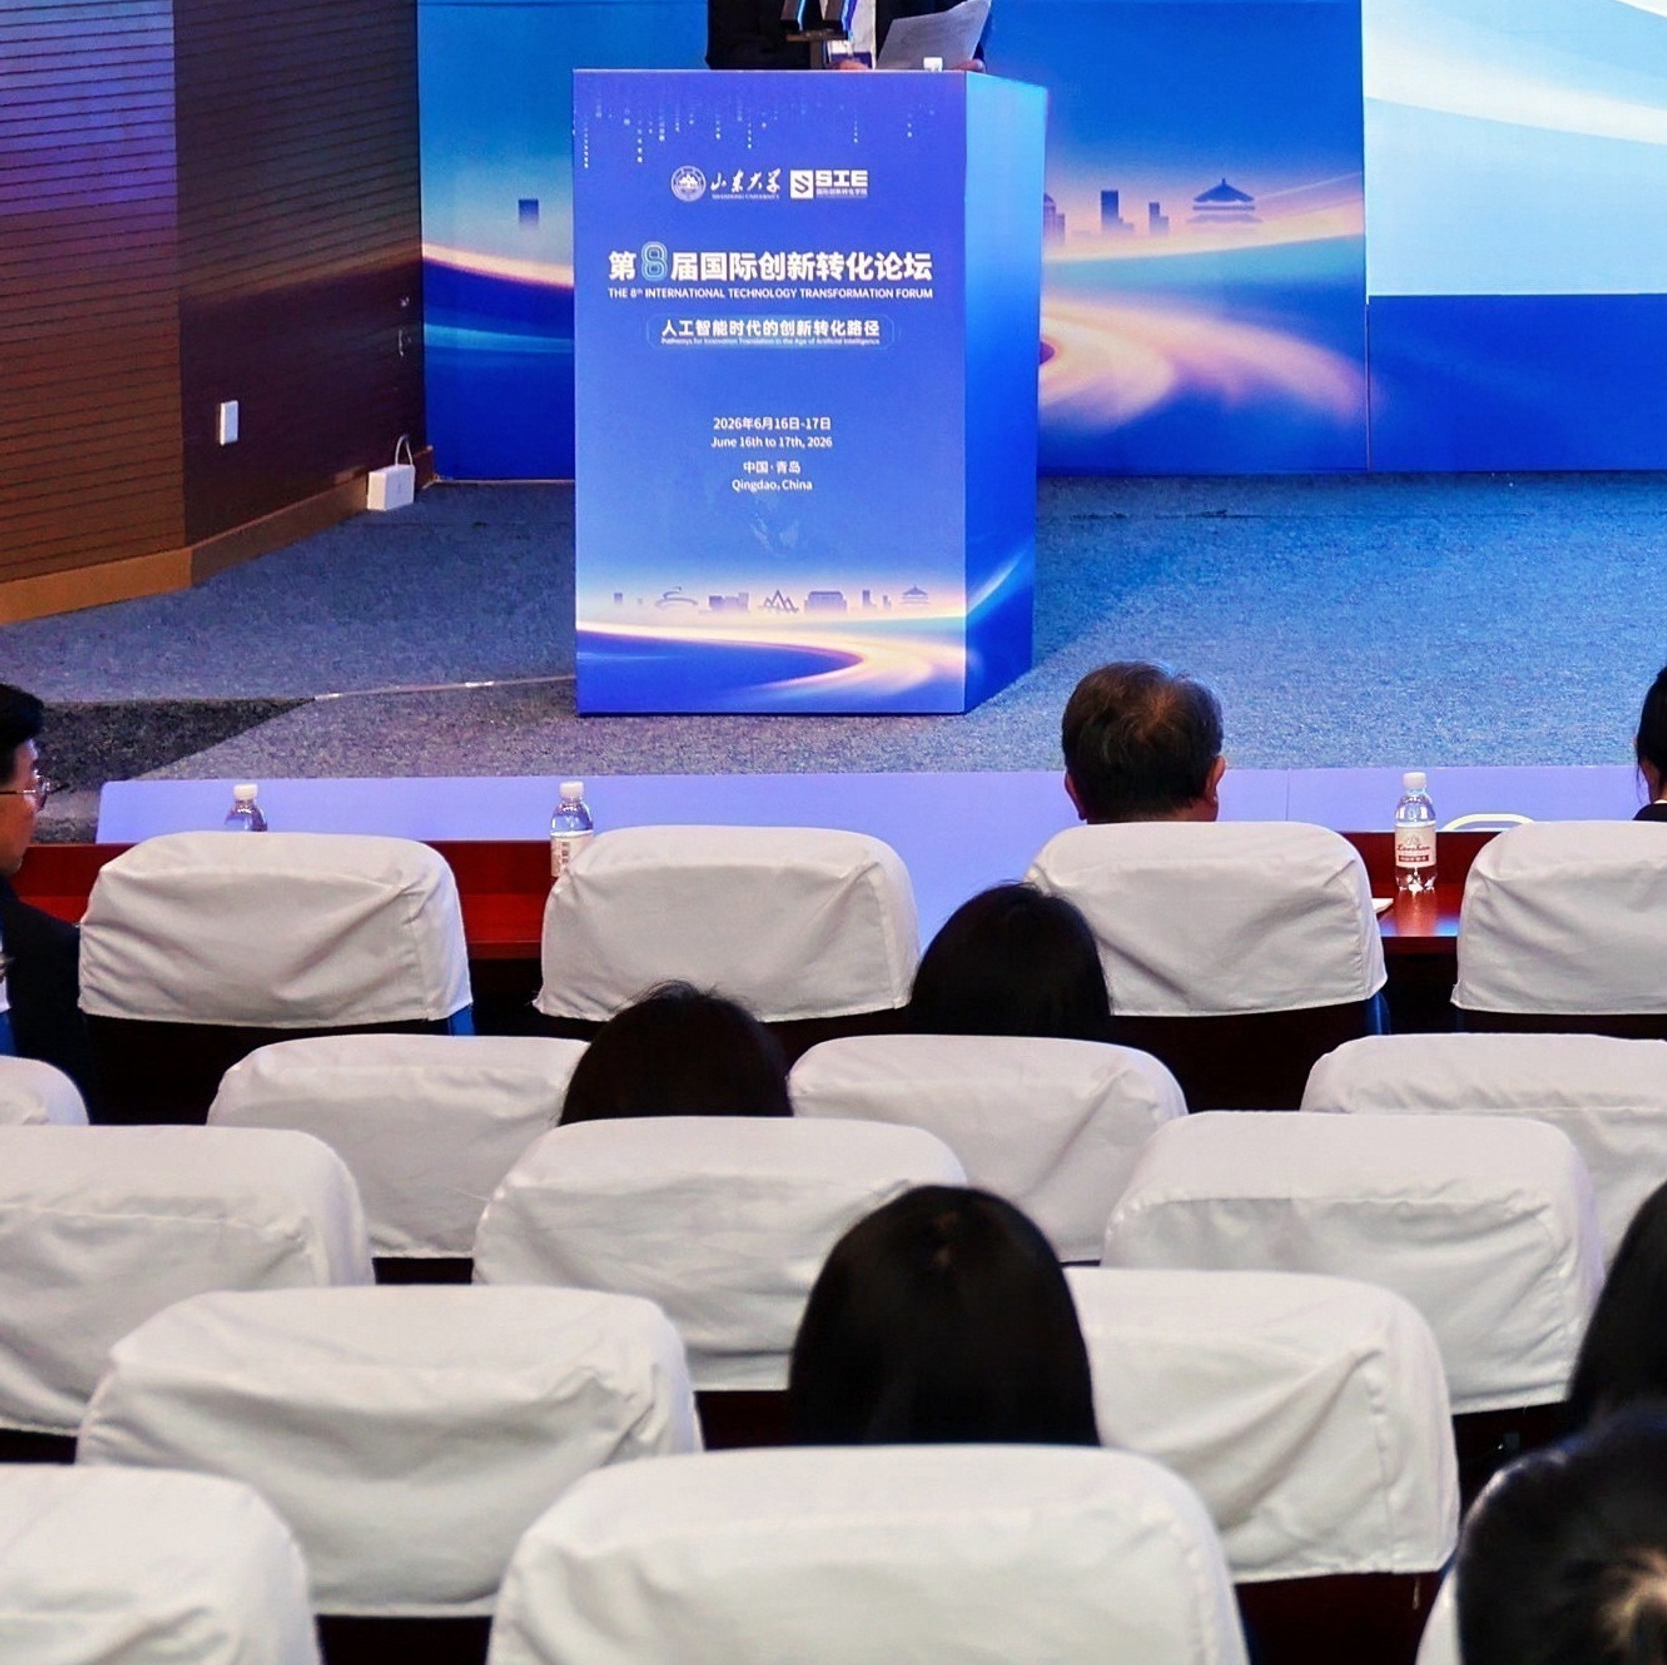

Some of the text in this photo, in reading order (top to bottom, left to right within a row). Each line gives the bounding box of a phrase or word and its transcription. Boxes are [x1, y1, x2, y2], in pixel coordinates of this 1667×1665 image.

[816, 171, 867, 187] SIE
[609, 288, 627, 298] THE
[645, 288, 724, 298] INTERNATIONAL
[729, 289, 796, 298] TECHNOLOGY
[800, 289, 893, 298] TRANSFORMATION
[896, 289, 932, 298] FORUM
[663, 320, 879, 336] 人工智能时代的创新转化路径
[714, 417, 830, 430] 2026年6月16日-17日
[712, 437, 832, 448] June 16th to 17th, 2026
[732, 480, 812, 492] Qingdao, China
